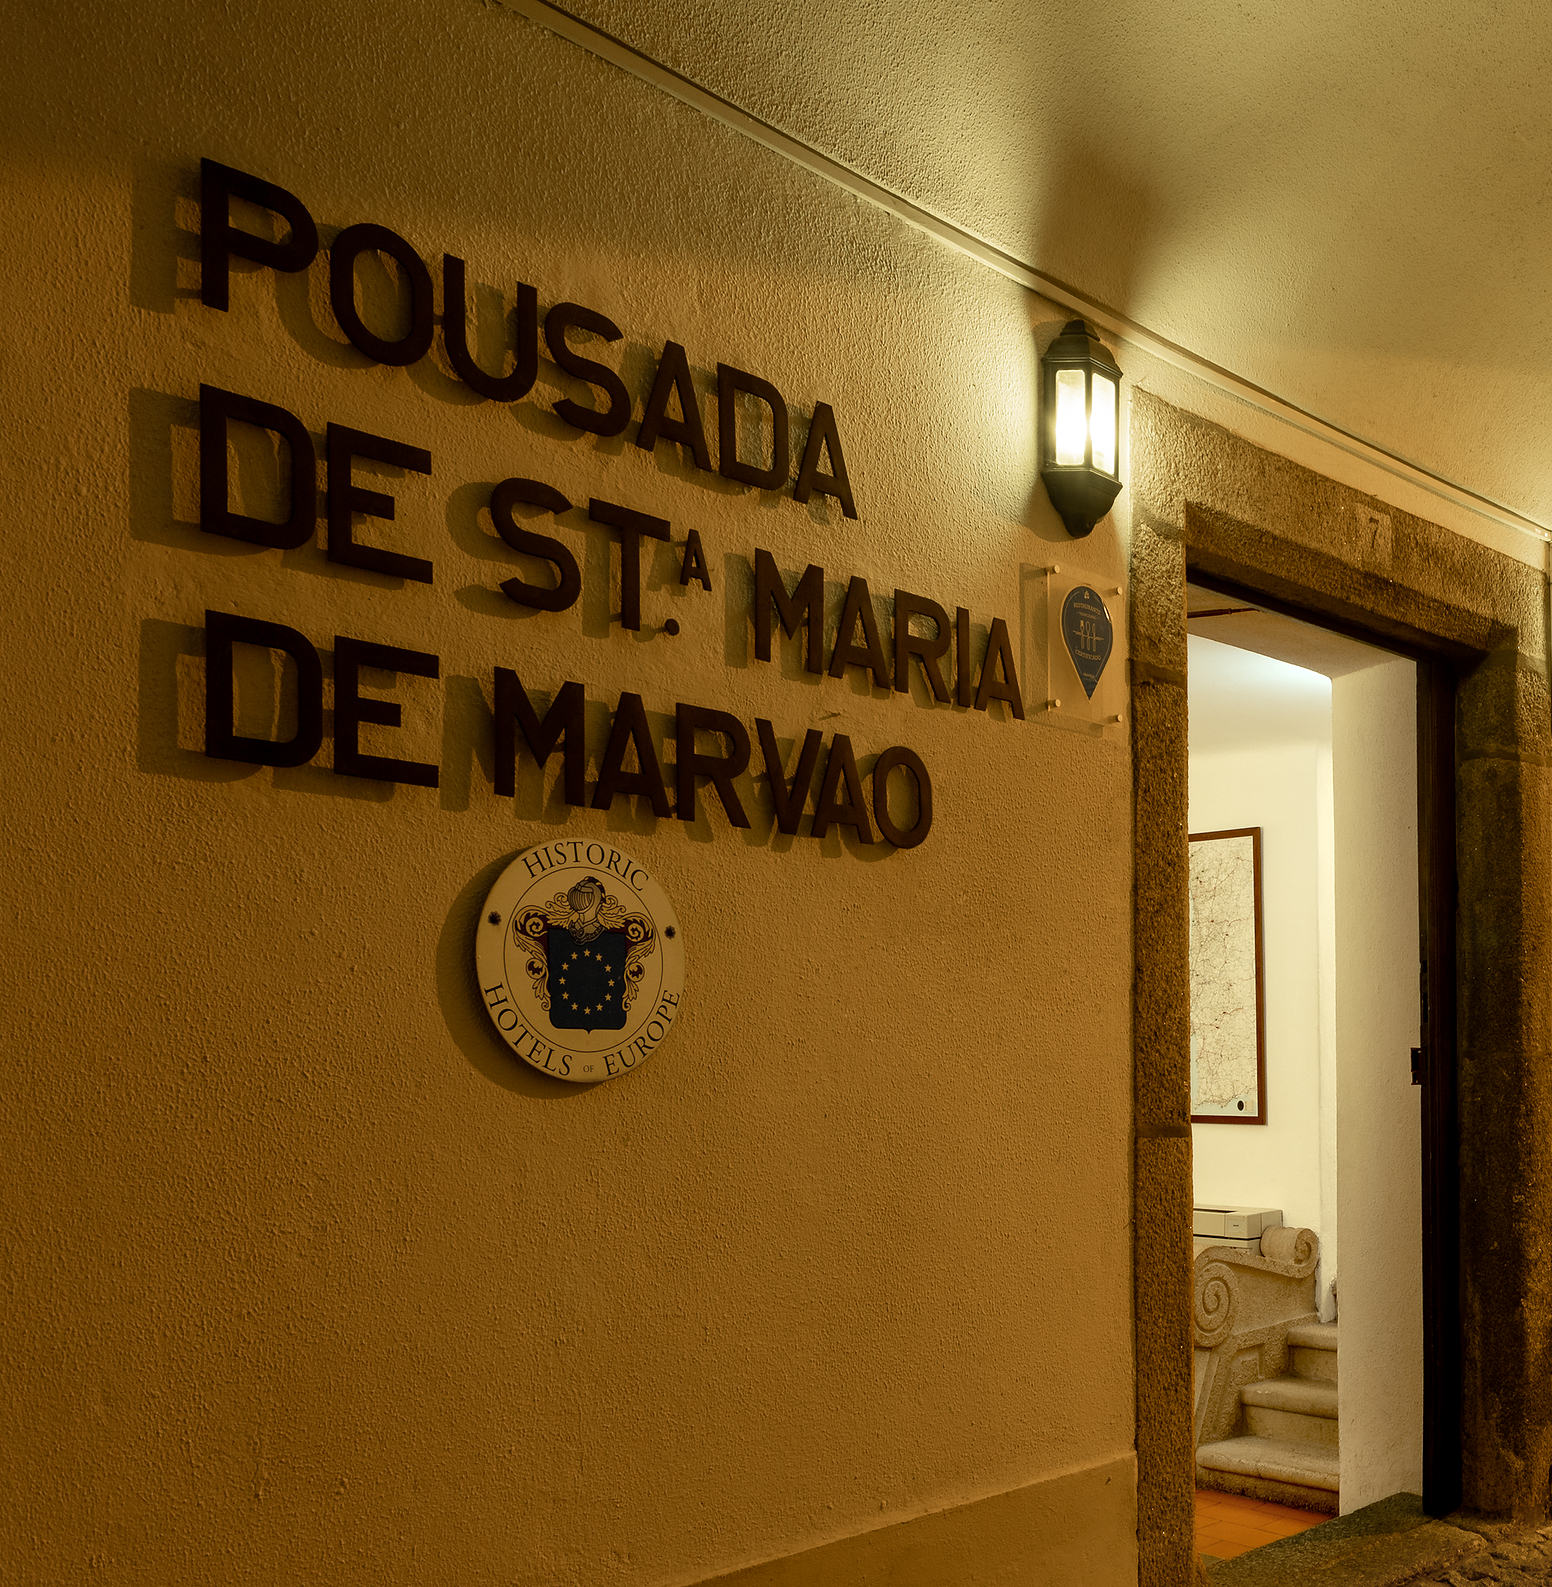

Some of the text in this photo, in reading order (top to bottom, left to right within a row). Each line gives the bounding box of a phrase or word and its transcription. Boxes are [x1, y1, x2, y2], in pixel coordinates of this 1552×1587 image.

[200, 157, 857, 520] POUSADA
[200, 383, 433, 585] DE
[754, 546, 1026, 721] MARIA
[205, 608, 932, 850] DE MARVAO
[1074, 649, 1102, 661] CERTIFICADO
[521, 841, 650, 892] HISTORIC
[484, 982, 681, 1077] HOTELS OF EUROPE
